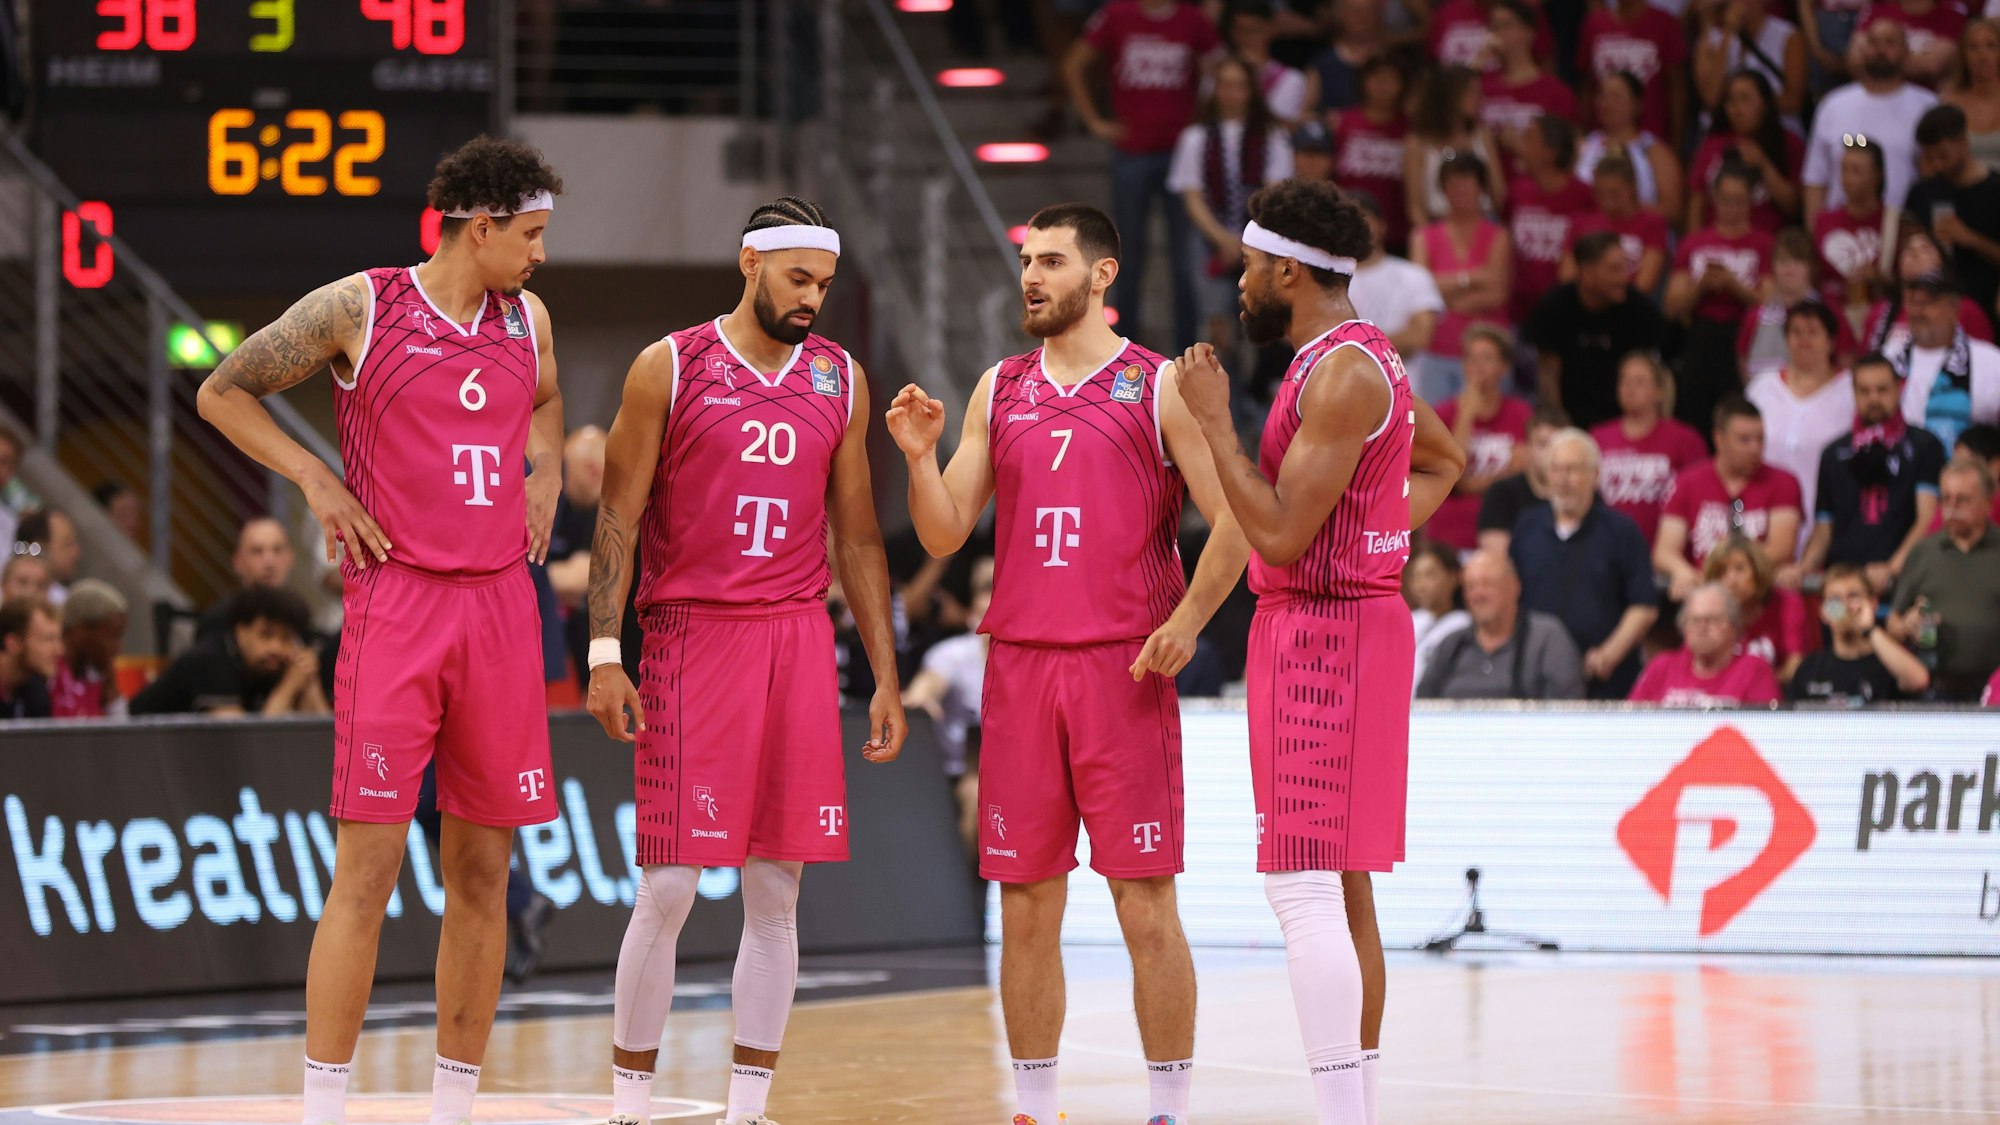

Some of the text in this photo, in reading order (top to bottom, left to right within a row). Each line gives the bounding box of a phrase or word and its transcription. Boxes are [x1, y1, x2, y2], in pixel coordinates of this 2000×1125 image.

[208, 109, 386, 196] 6:22
[406, 344, 442, 357] SPALDING
[459, 368, 487, 412] 6
[816, 381, 837, 393] BBL
[703, 395, 741, 407] SPALDING
[1114, 389, 1137, 400] BBL
[1008, 411, 1039, 423] SPALDING
[740, 420, 797, 466] 20
[1051, 429, 1073, 471] 7
[359, 786, 398, 799] SPALDING
[691, 828, 728, 840] SPALDING
[986, 846, 1017, 859] SPALDING
